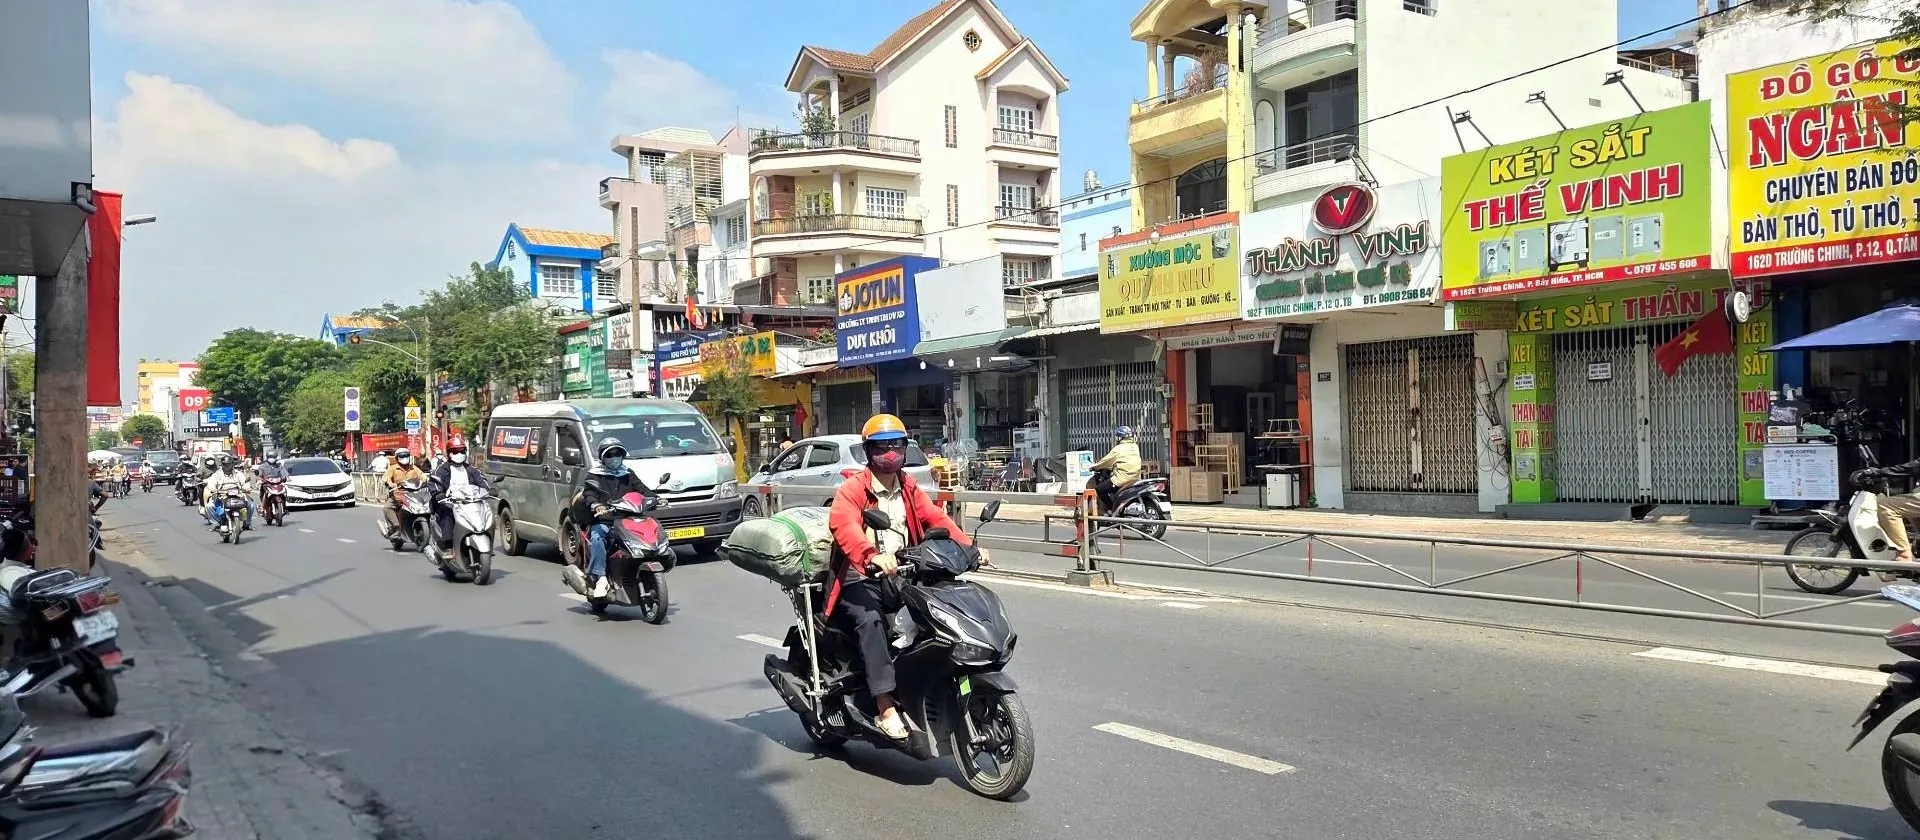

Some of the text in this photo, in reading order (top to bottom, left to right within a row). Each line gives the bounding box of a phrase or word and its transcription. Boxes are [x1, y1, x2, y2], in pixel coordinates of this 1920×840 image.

[1760, 63, 1812, 100] ĐỒ
[1827, 47, 1879, 88] GỖ
[1749, 87, 1907, 169] NGÂN
[1490, 123, 1652, 184] KÉT SẮT
[1766, 167, 1838, 203] CHUYÊN
[1846, 160, 1884, 193] BÁN
[1464, 163, 1684, 231] THẾ VINH
[1743, 213, 1777, 244] BÀN
[1784, 207, 1826, 239] THỜ,
[1831, 200, 1855, 233] TỦ
[1173, 242, 1202, 264] MỘC
[1352, 220, 1430, 265] VINH
[1633, 264, 1657, 274] 0797
[1659, 260, 1677, 271] 455
[1748, 254, 1772, 270] 162D
[1775, 247, 1815, 267] TRƯỜNG
[1818, 244, 1853, 262] CHINH,
[1585, 271, 1604, 280] HCM
[853, 274, 901, 310] JOTUN
[1514, 306, 1556, 332] KÉT
[1564, 295, 1613, 327] SẮT
[1623, 285, 1703, 323] THẦN
[847, 324, 896, 350] DUY KHÔI
[1238, 333, 1255, 341] THEO
[1258, 331, 1270, 339] YÊU
[1744, 318, 1767, 343] KÉT
[1513, 340, 1532, 363] KÉT
[184, 396, 204, 407] 09
[1514, 426, 1535, 449] TÀI
[1744, 417, 1766, 443] TÀ
